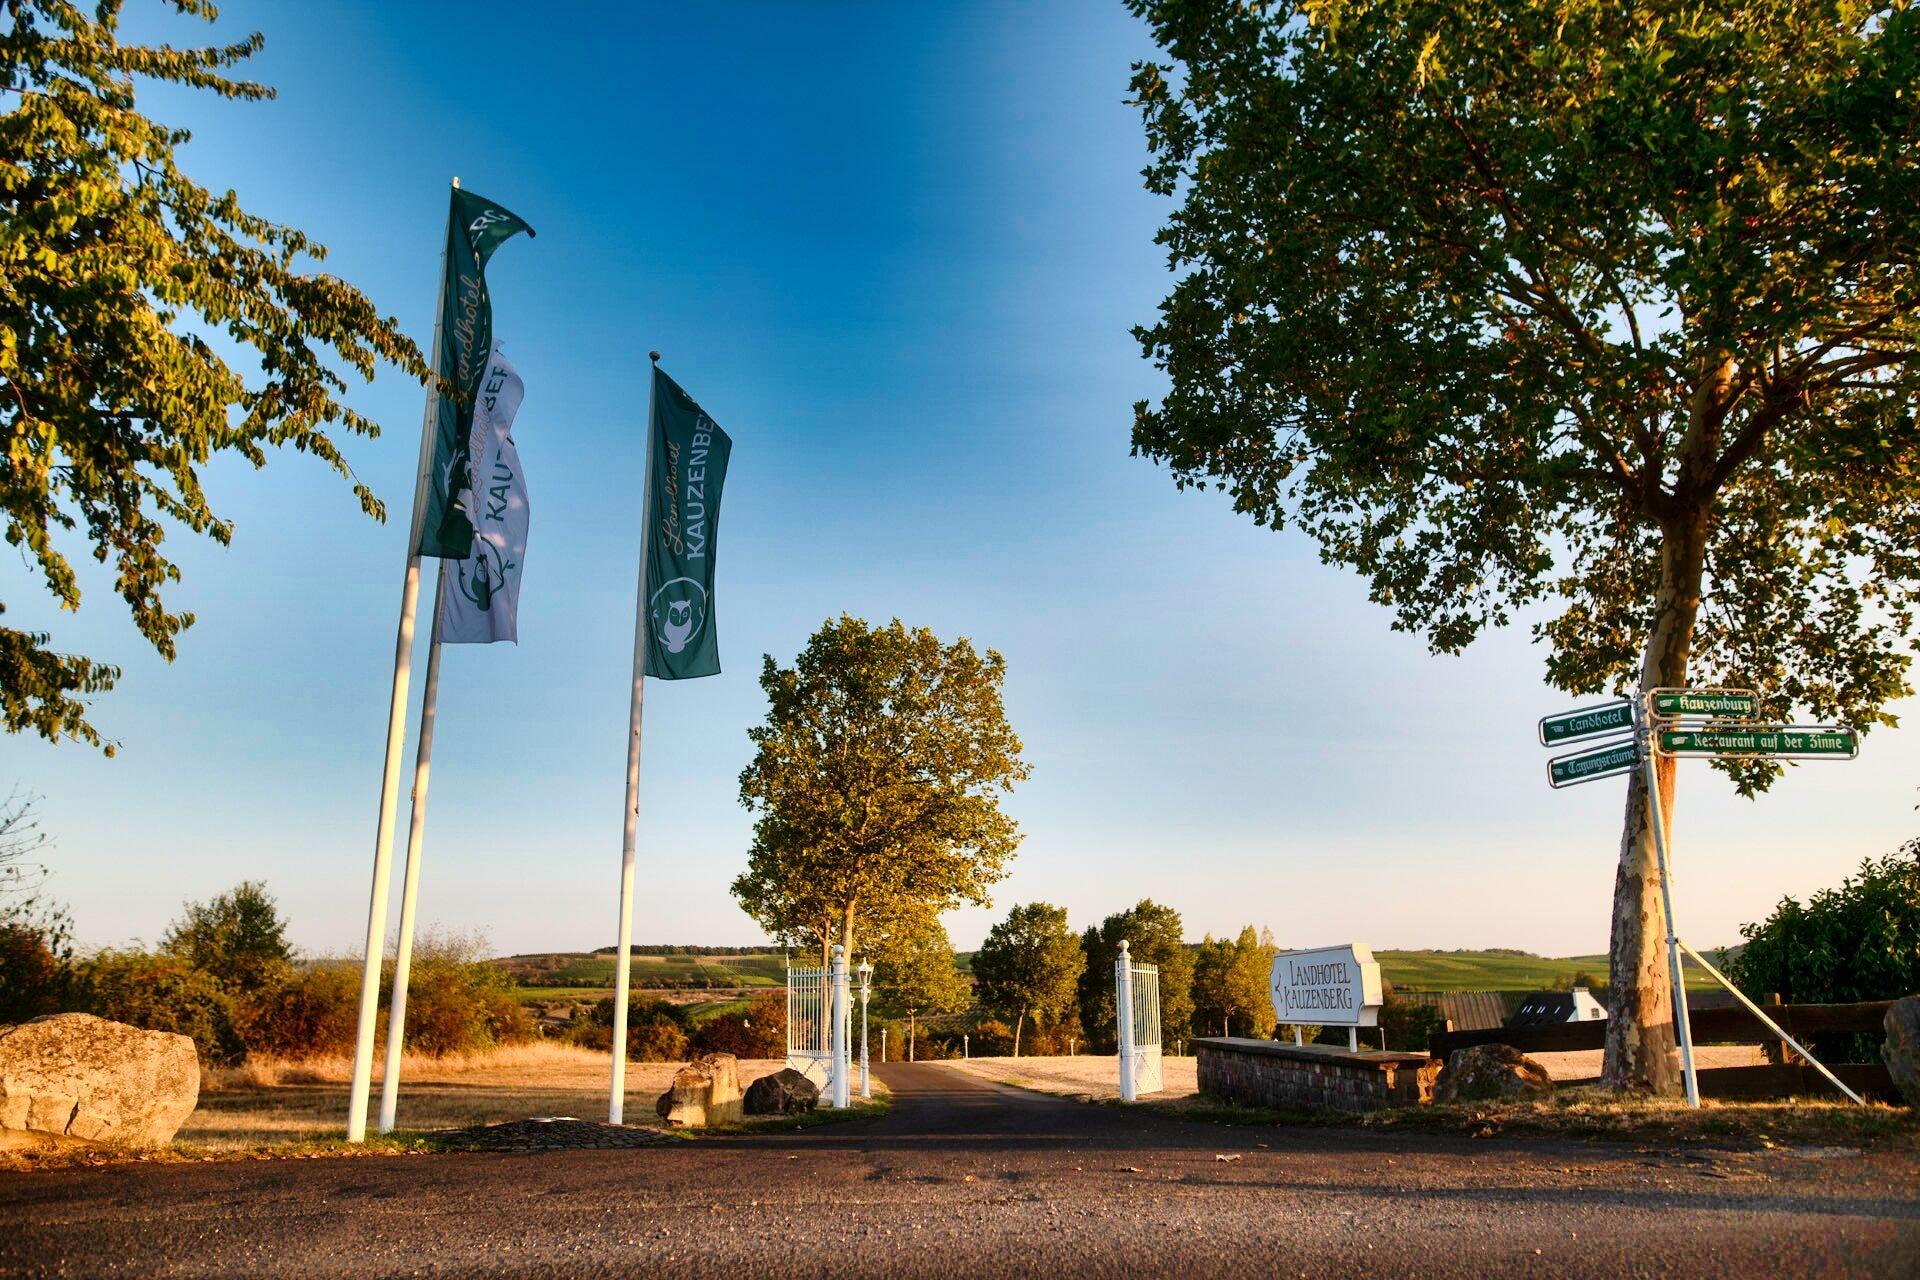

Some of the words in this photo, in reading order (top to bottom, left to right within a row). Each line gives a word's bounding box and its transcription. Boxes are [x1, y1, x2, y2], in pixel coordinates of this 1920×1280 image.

[453, 275, 481, 396] andhotel
[661, 440, 684, 556] Landhotel
[1680, 696, 1752, 713] Kauzenburg
[1569, 708, 1623, 732] Landhotel
[1760, 735, 1778, 751] auf
[1784, 734, 1803, 748] der
[1809, 734, 1842, 749] Zinne
[1289, 960, 1351, 987] LANDHOTEL
[1284, 986, 1353, 1017] KAUZENBERG
